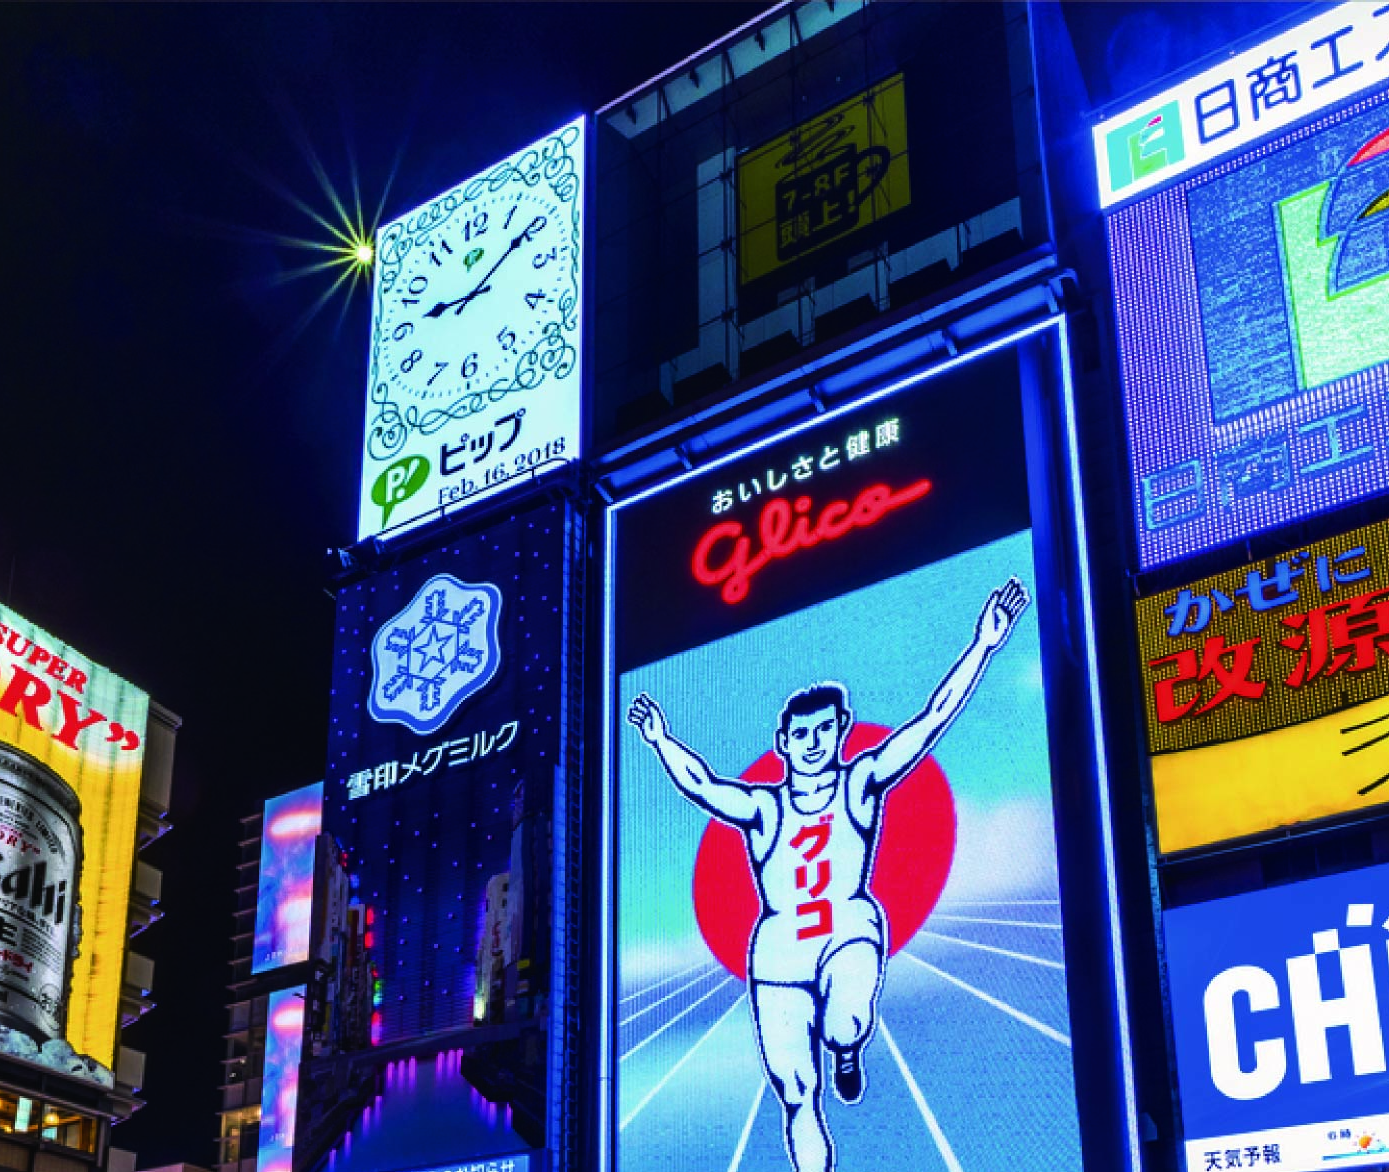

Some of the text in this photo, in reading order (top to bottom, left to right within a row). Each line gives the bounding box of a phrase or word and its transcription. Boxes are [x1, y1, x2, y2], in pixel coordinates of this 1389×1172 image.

[464, 212, 489, 242] 12
[503, 205, 518, 230] 1
[430, 239, 453, 267] 11
[532, 247, 557, 269] 3
[401, 276, 428, 305] 10
[524, 289, 547, 310] 4
[392, 322, 414, 342] 9
[496, 326, 516, 350] 5
[400, 349, 423, 374] 8
[427, 361, 449, 386] 7
[461, 352, 479, 378] 6
[440, 408, 527, 476] ピップ
[438, 479, 479, 504] Feb.
[514, 436, 566, 470] 2018
[712, 418, 899, 515] おいしさと健康
[692, 479, 932, 605] Glico
[1162, 545, 1371, 639] かぜに
[346, 721, 519, 800] 雪印メグミルク
[789, 812, 835, 942] グリコ
[1203, 1143, 1283, 1172] 天気予報
